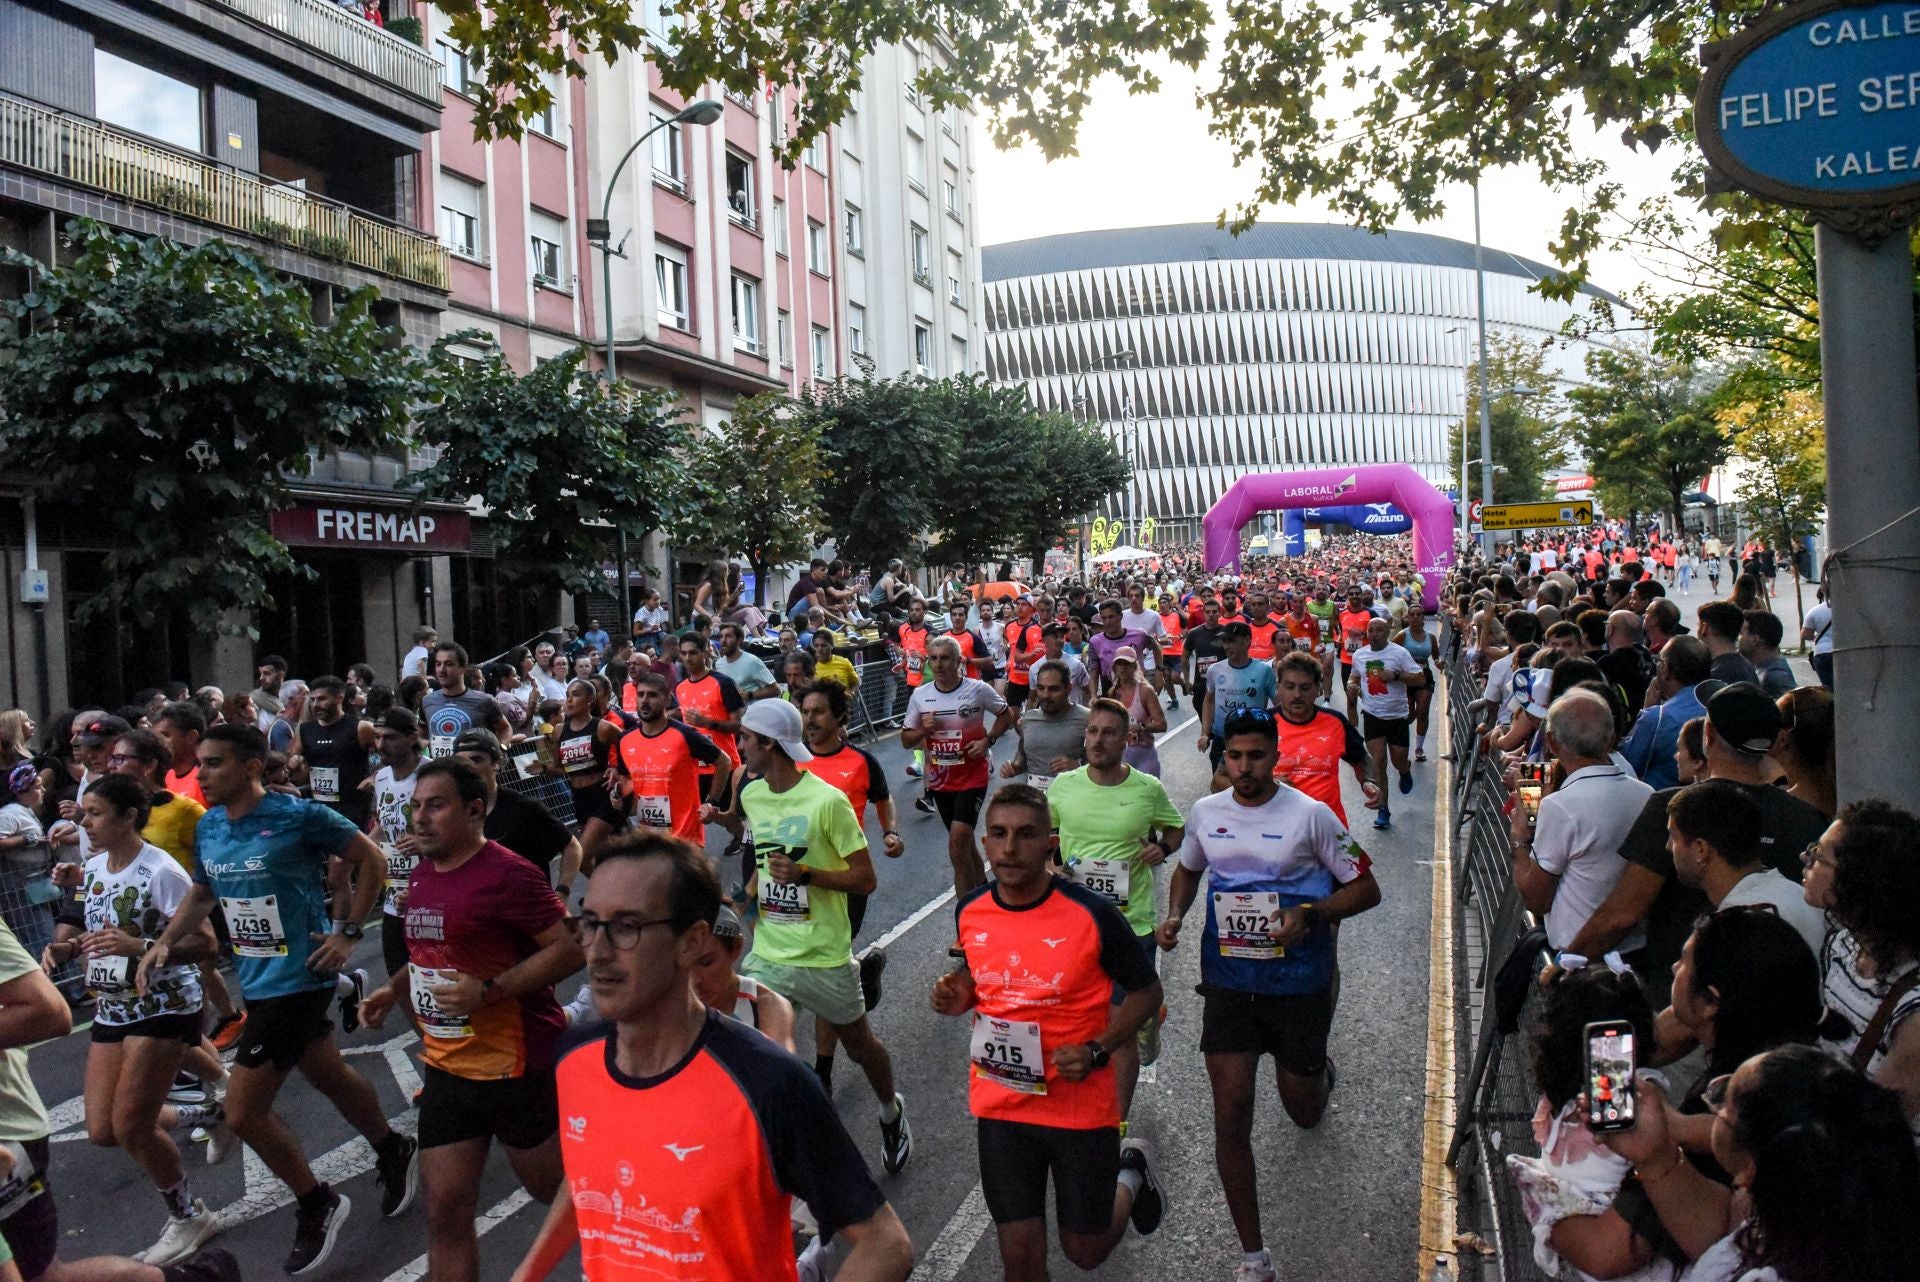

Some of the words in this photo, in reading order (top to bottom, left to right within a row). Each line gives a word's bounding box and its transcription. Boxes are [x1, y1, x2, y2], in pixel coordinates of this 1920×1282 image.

[1809, 9, 1920, 46] CALLE
[1720, 83, 1838, 130] FELIPE
[1284, 486, 1333, 498] LABORAL
[1364, 514, 1405, 524] MIZUNO
[1484, 509, 1507, 517] Hotel
[317, 508, 436, 544] FREMAP
[1509, 517, 1558, 526] Euskalduna
[1417, 566, 1449, 574] LABORAL
[435, 747, 454, 757] 290
[931, 742, 960, 752] 21173
[562, 747, 591, 760] 20984
[641, 808, 665, 819] 1944
[1086, 877, 1115, 893] 935
[765, 882, 799, 901] 1473
[233, 918, 272, 934] 2438
[1225, 915, 1270, 933] 1672
[984, 1041, 1023, 1065] 915
[674, 1252, 705, 1264] FEST
